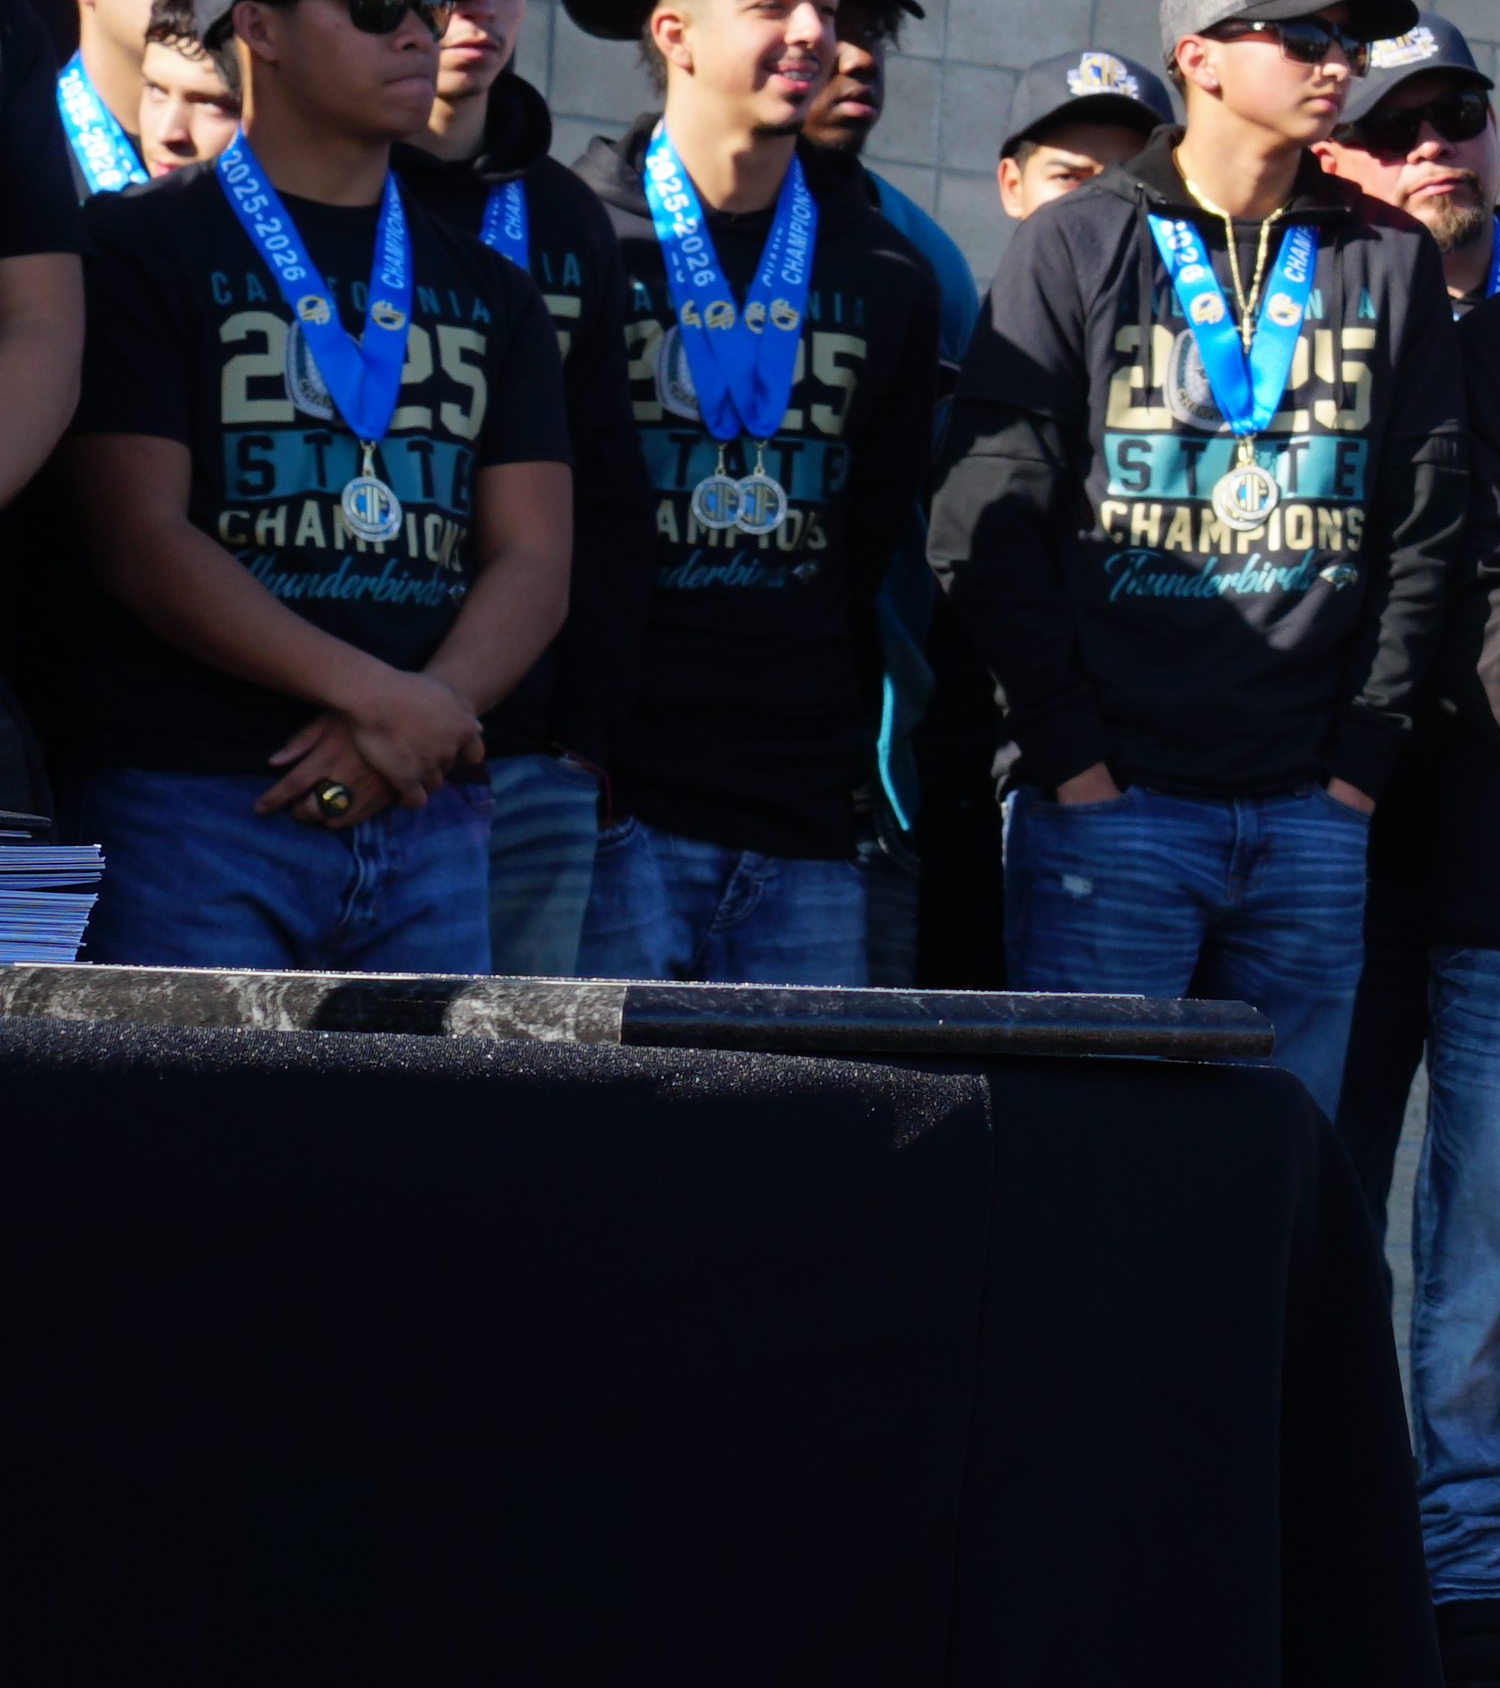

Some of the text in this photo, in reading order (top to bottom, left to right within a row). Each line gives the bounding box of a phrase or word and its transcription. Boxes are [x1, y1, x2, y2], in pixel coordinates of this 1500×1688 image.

[58, 68, 122, 188] 2025-2026
[220, 150, 307, 282] 2025-2026
[645, 147, 716, 288] 2025-2026
[1103, 547, 1317, 603] Thunderbirds
